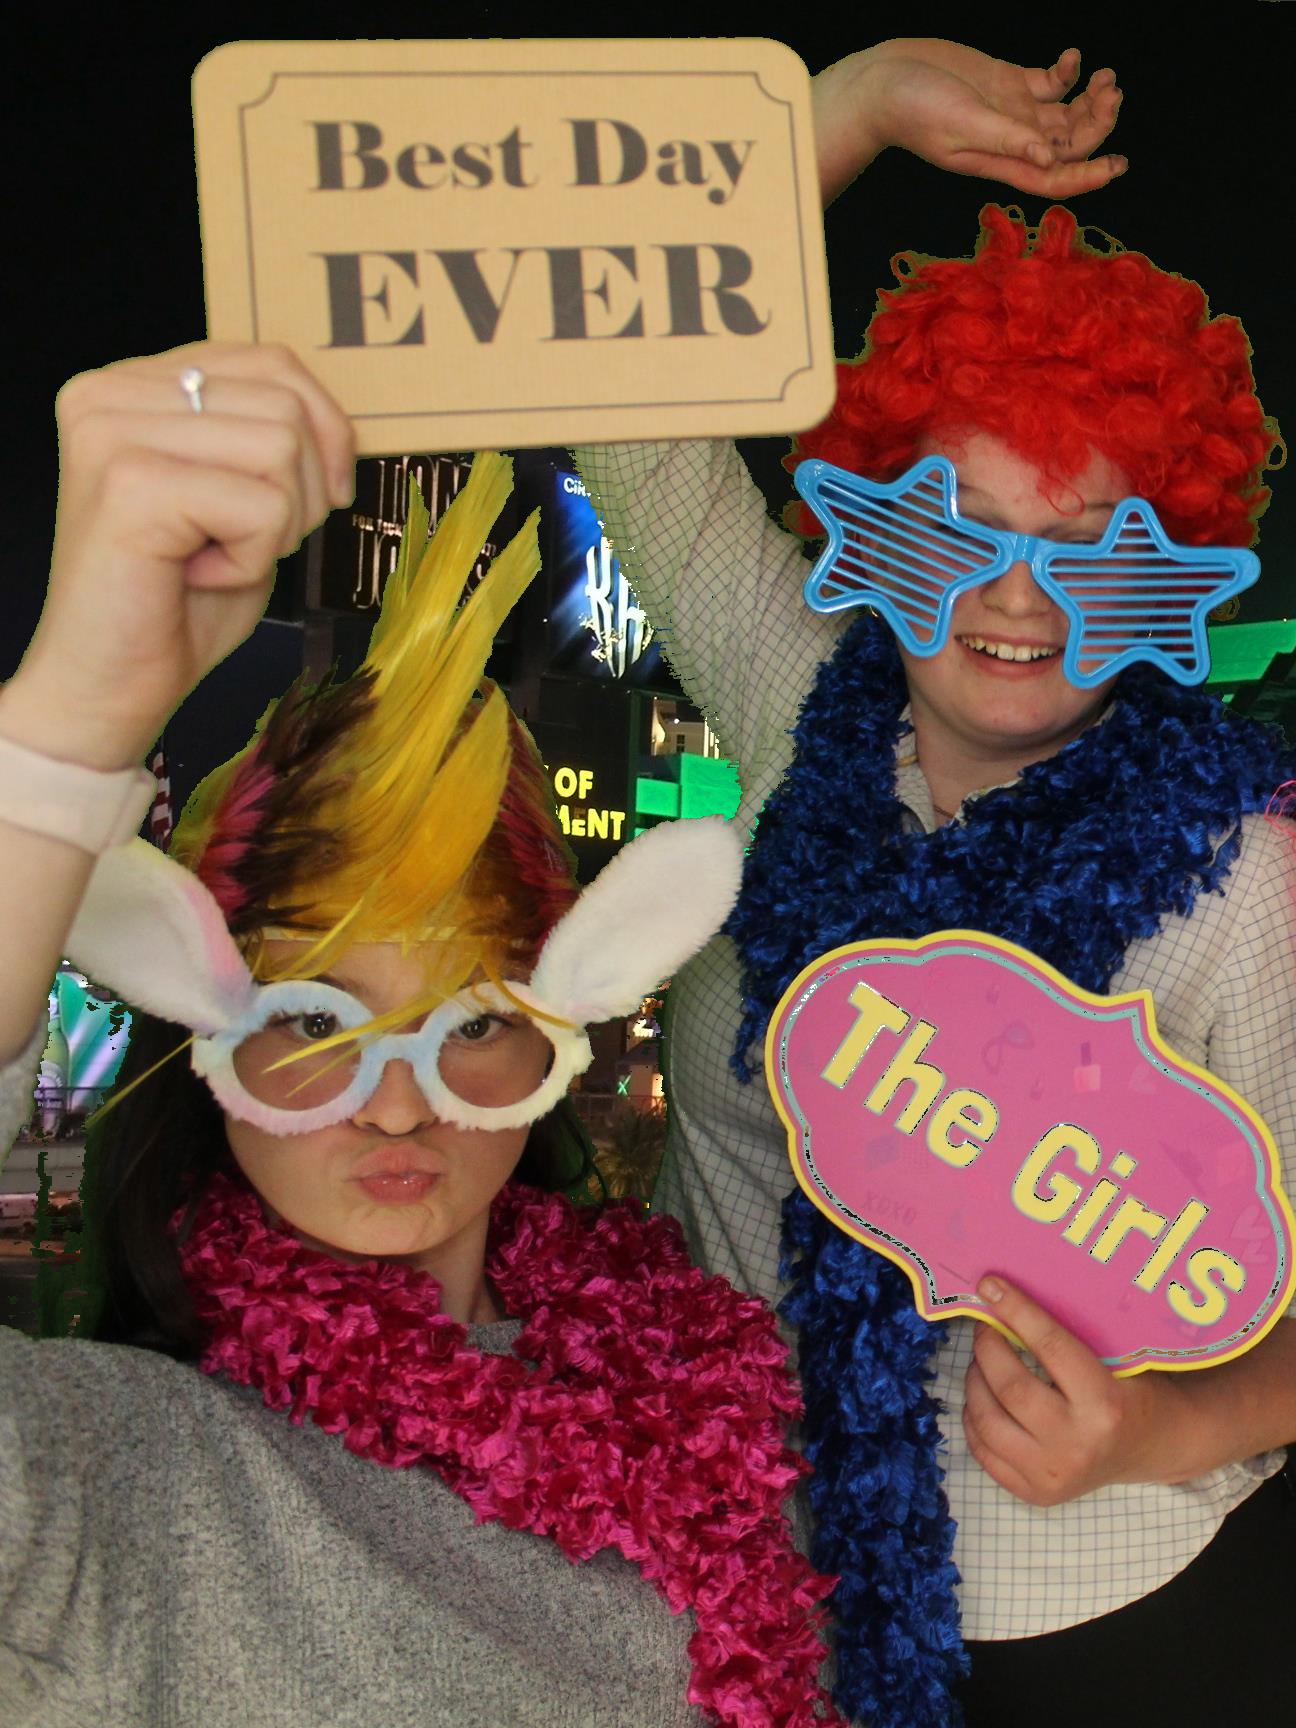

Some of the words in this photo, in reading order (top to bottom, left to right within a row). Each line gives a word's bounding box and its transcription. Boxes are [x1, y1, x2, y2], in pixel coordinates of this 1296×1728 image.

[305, 119, 539, 192] Best
[561, 118, 757, 205] Day
[309, 243, 772, 348] EVER
[554, 767, 594, 799] OF
[821, 982, 998, 1168] The
[1011, 1123, 1246, 1327] Girls
